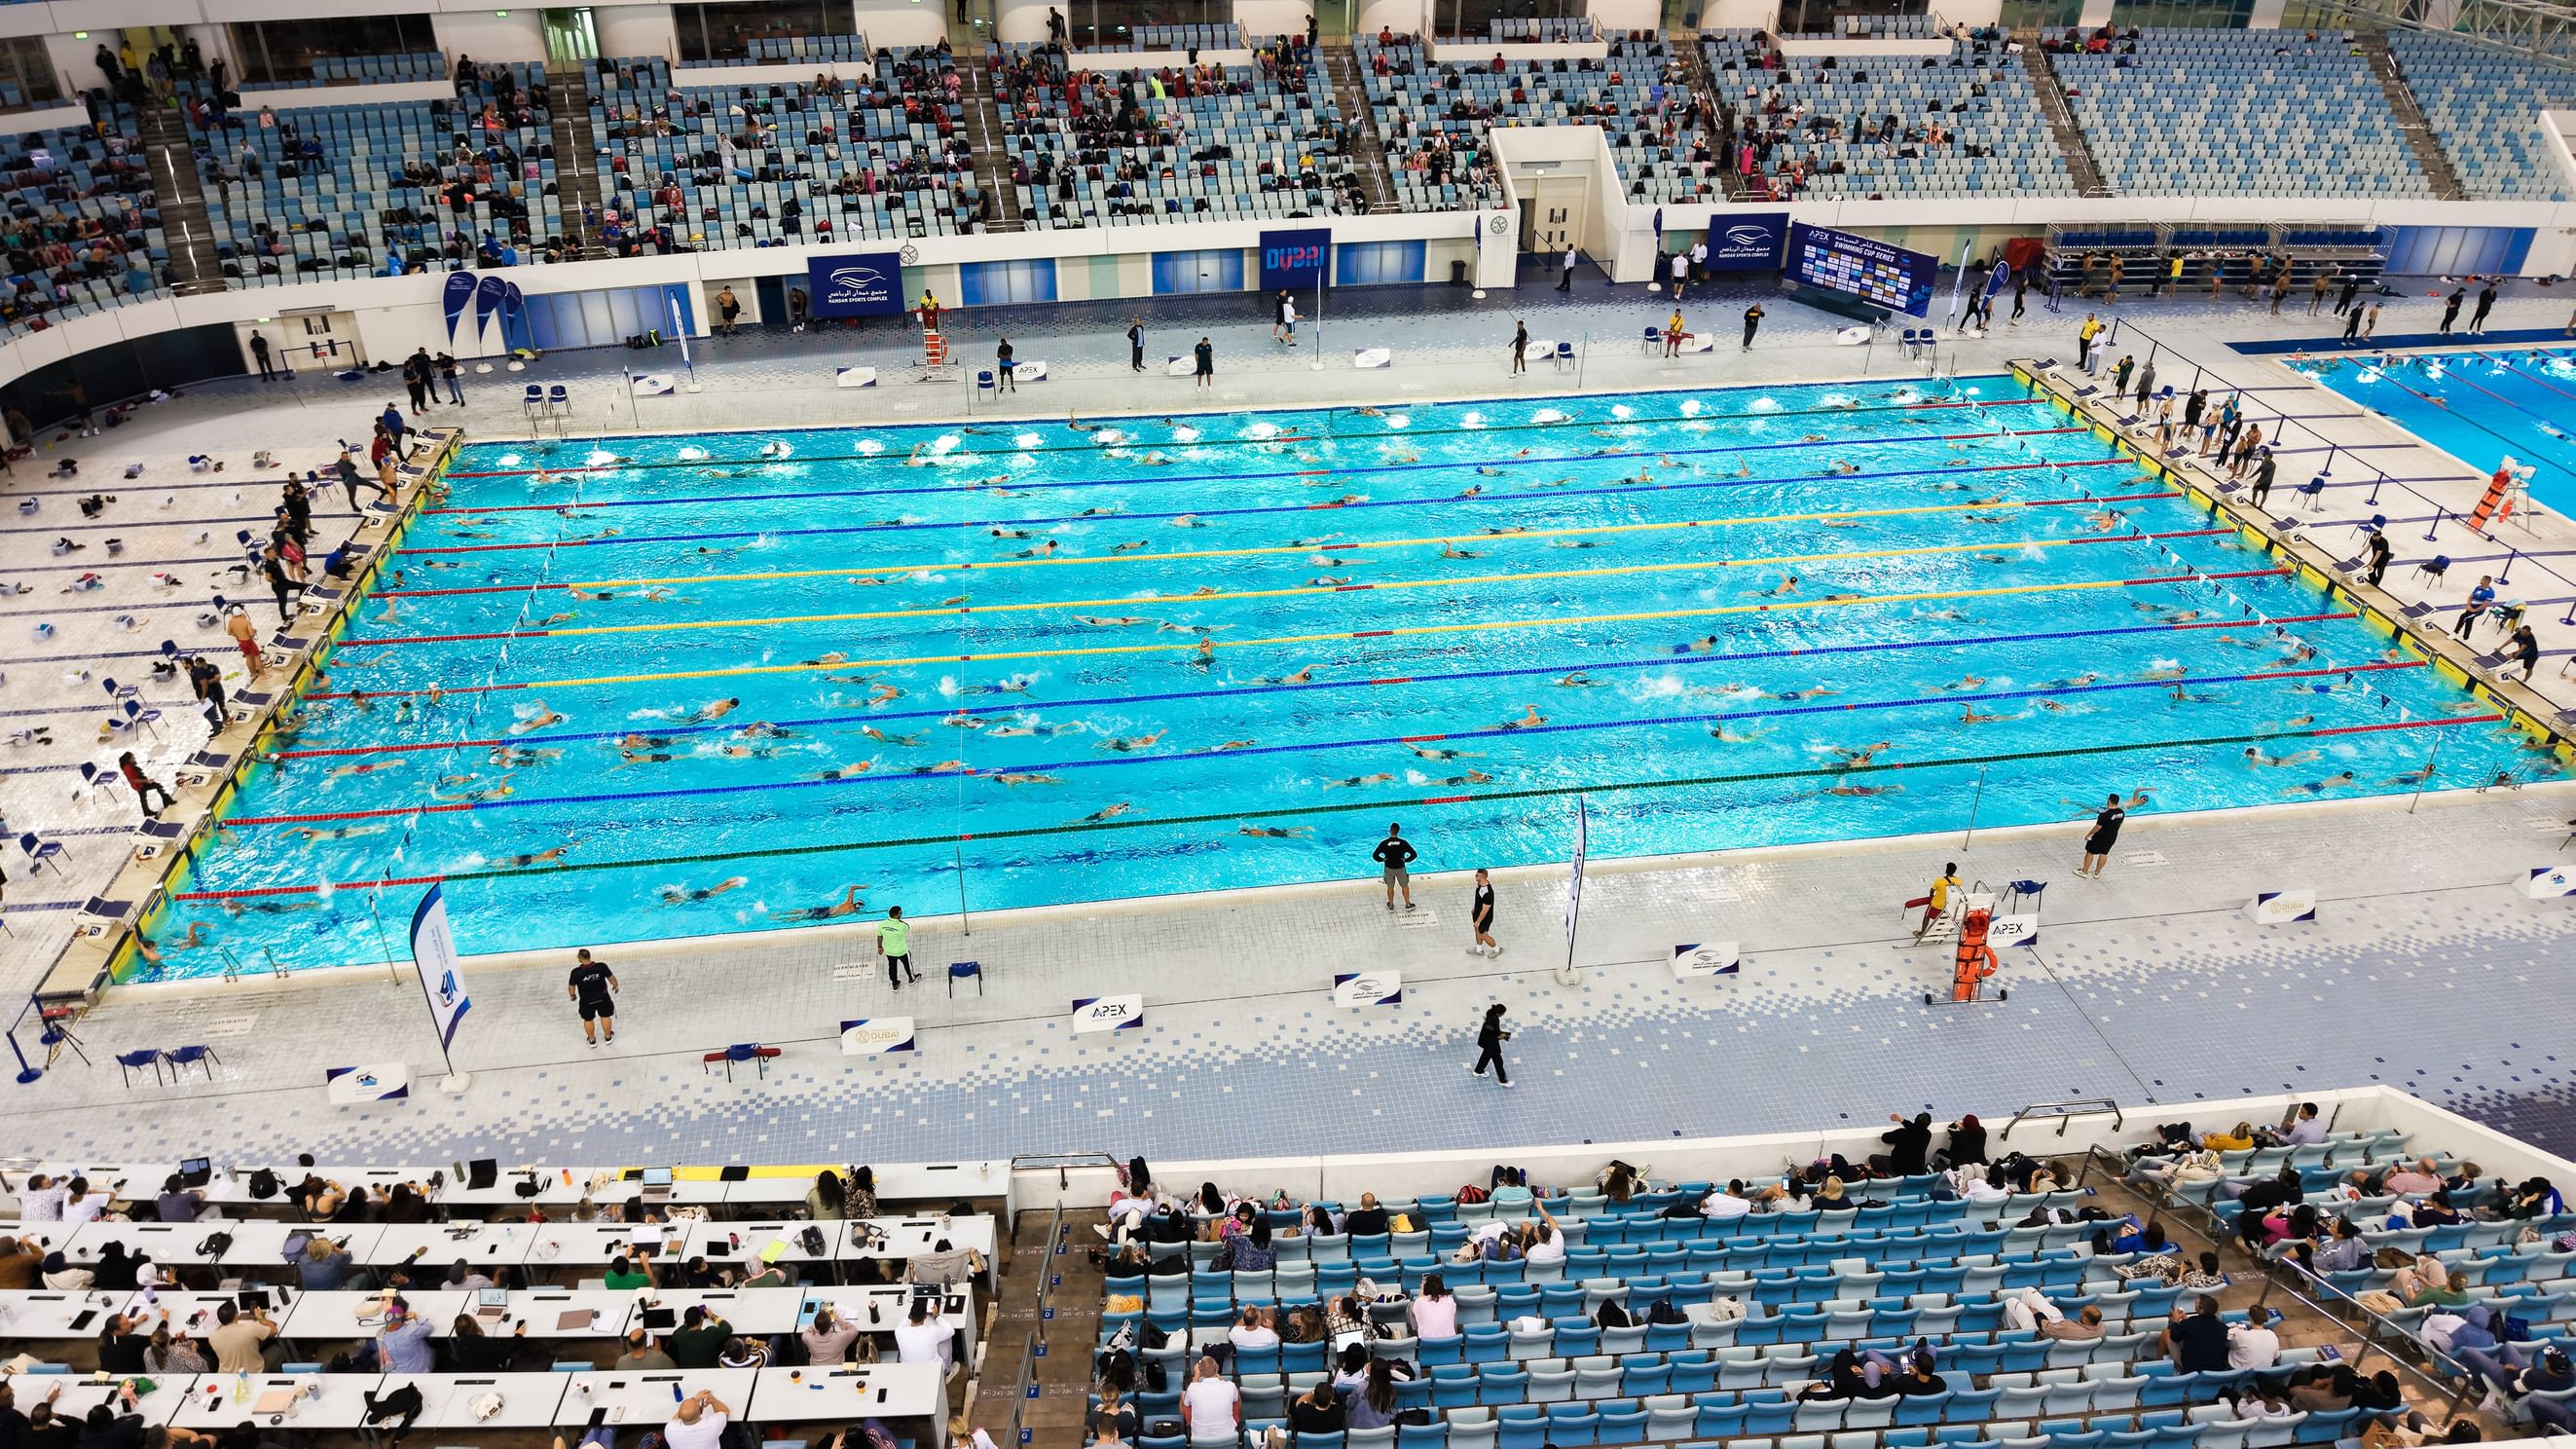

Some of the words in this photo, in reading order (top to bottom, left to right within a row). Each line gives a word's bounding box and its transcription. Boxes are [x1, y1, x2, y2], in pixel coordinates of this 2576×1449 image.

[1809, 230, 1829, 241] APEX
[1267, 245, 1324, 270] DUBAI
[1834, 242, 1863, 253] SWIMMING
[1863, 248, 1874, 257] CUP
[1875, 252, 1895, 262] SERIES
[1993, 923, 2023, 935] APEX
[1091, 1004, 1126, 1018] APEX
[871, 1030, 899, 1039] DUBAI
